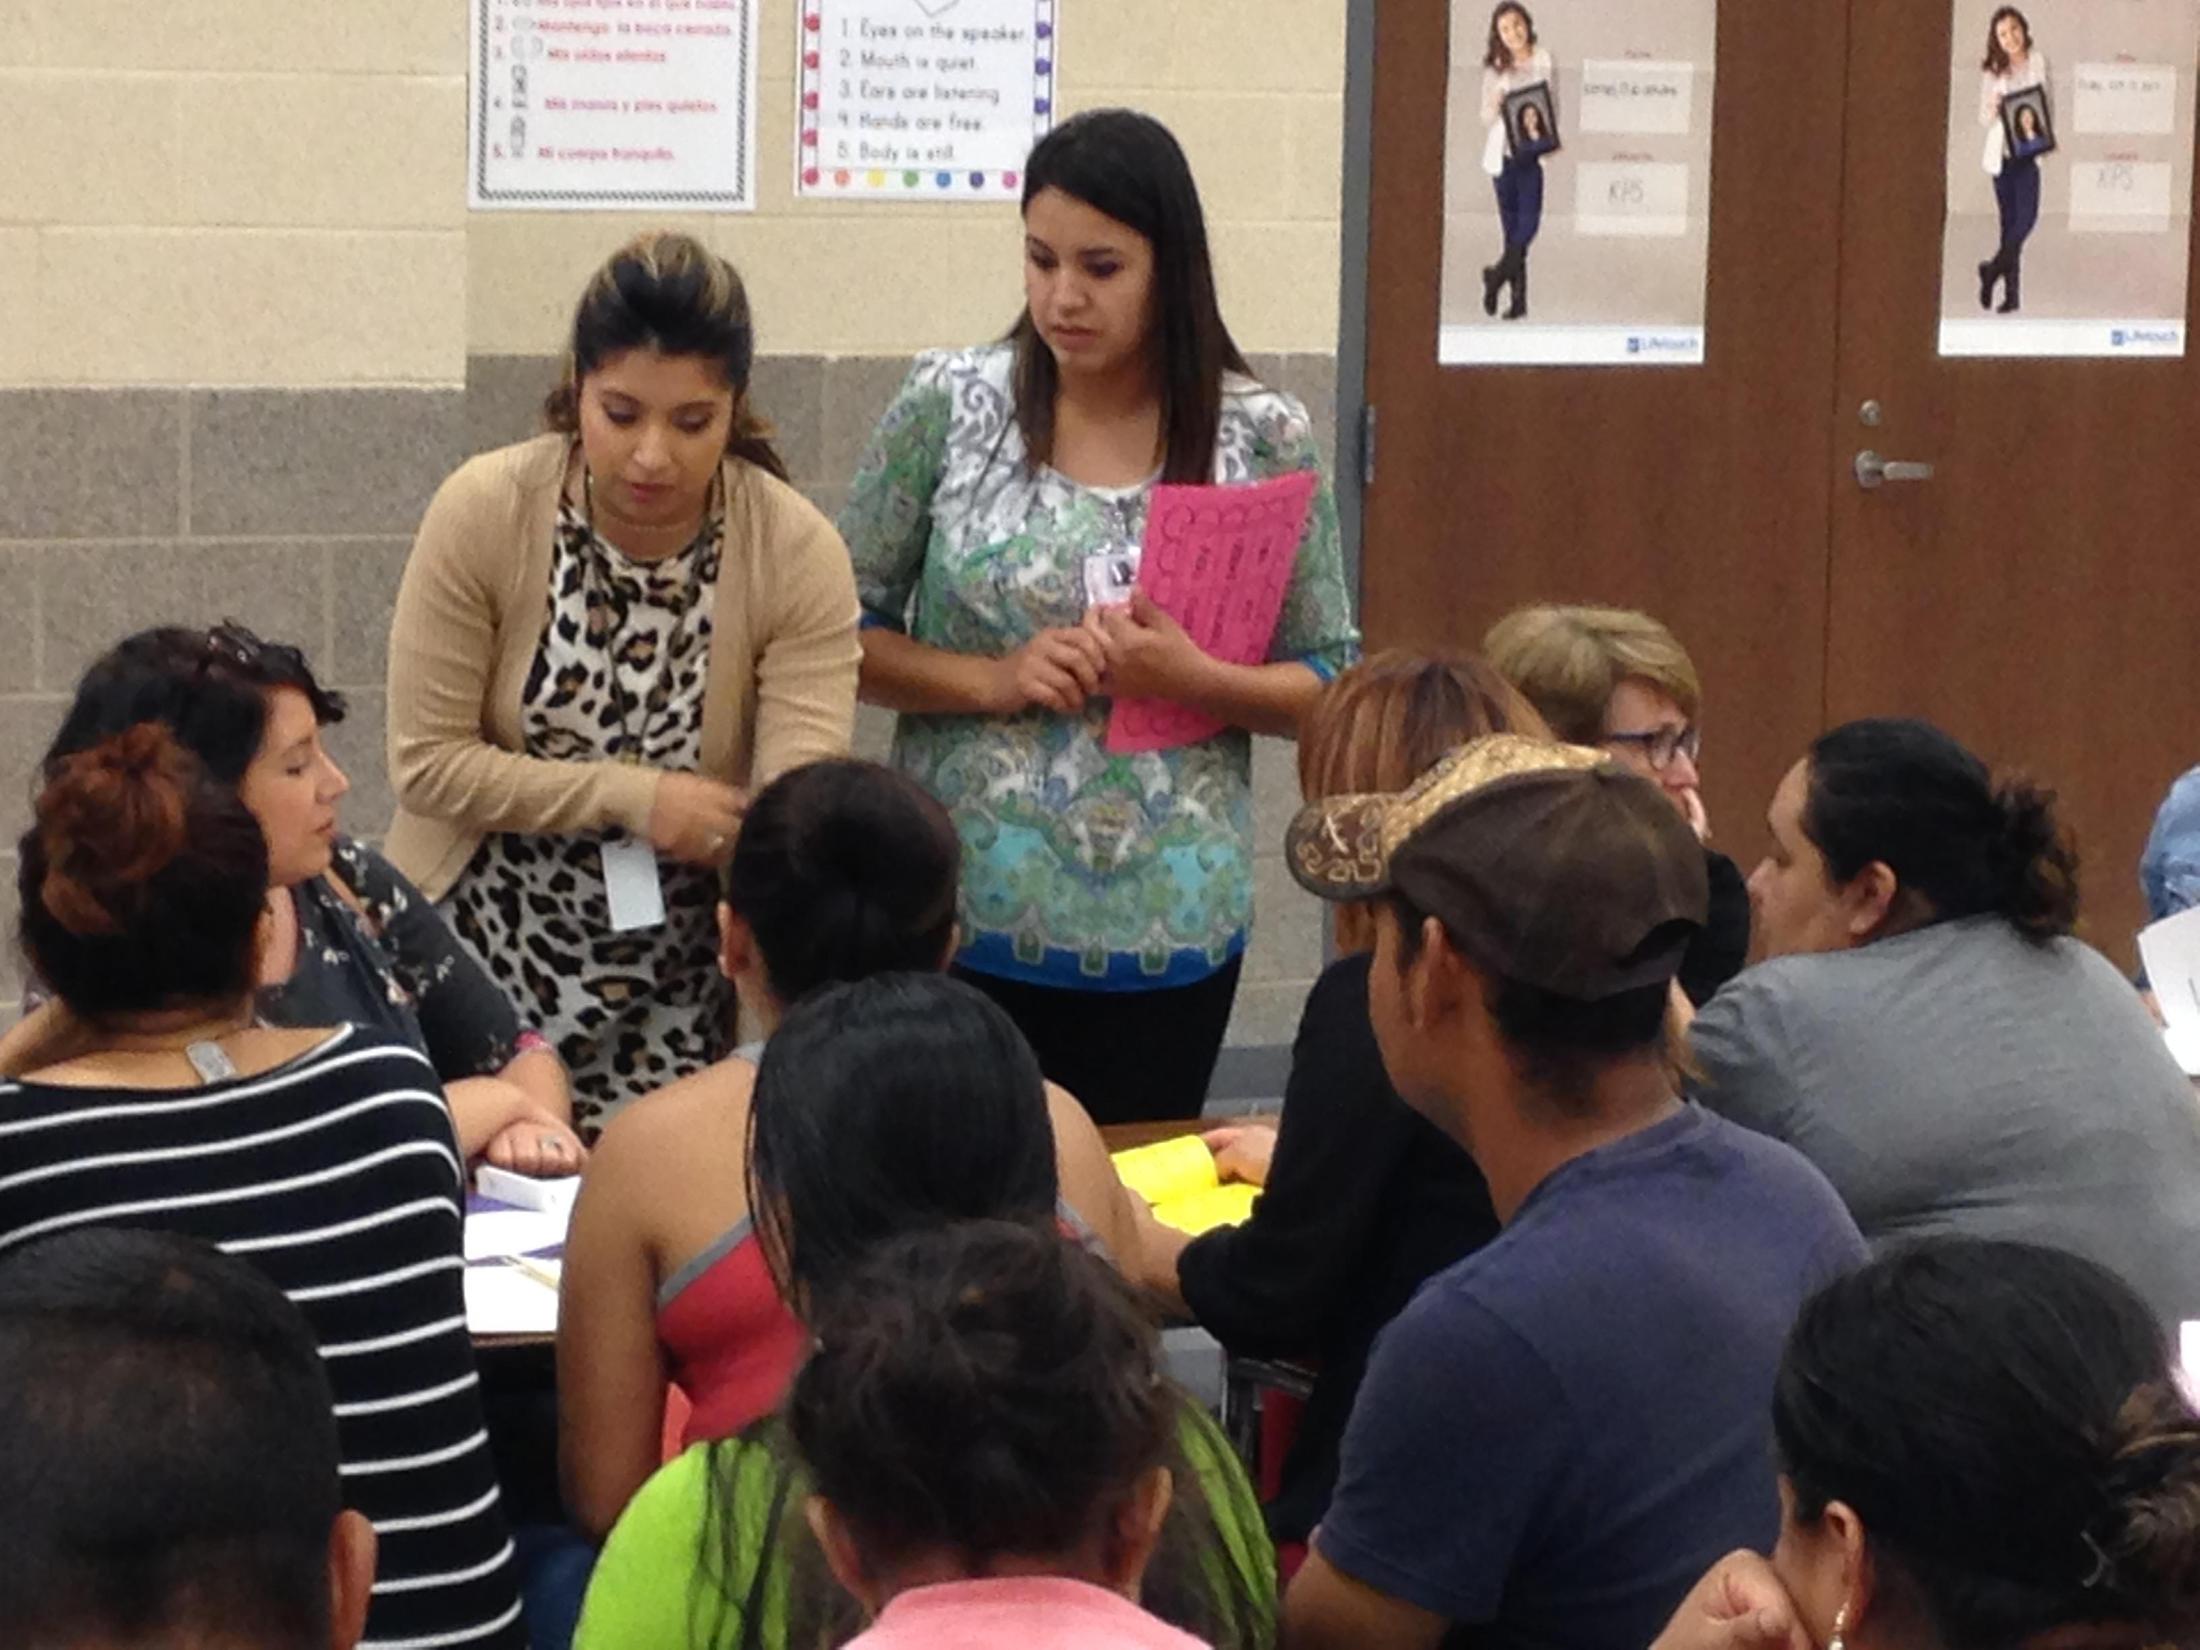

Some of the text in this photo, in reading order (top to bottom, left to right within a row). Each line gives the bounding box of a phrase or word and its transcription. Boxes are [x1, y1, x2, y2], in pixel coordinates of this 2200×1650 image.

[859, 17, 897, 42] Eyes
[904, 26, 924, 40] on
[929, 22, 955, 41] the
[859, 48, 910, 70] Mouth
[916, 57, 929, 70] is
[859, 78, 896, 101] Ears
[902, 86, 928, 101] are
[859, 111, 909, 132] Hands
[915, 117, 942, 132] are
[859, 140, 899, 164] Body
[906, 147, 919, 161] is
